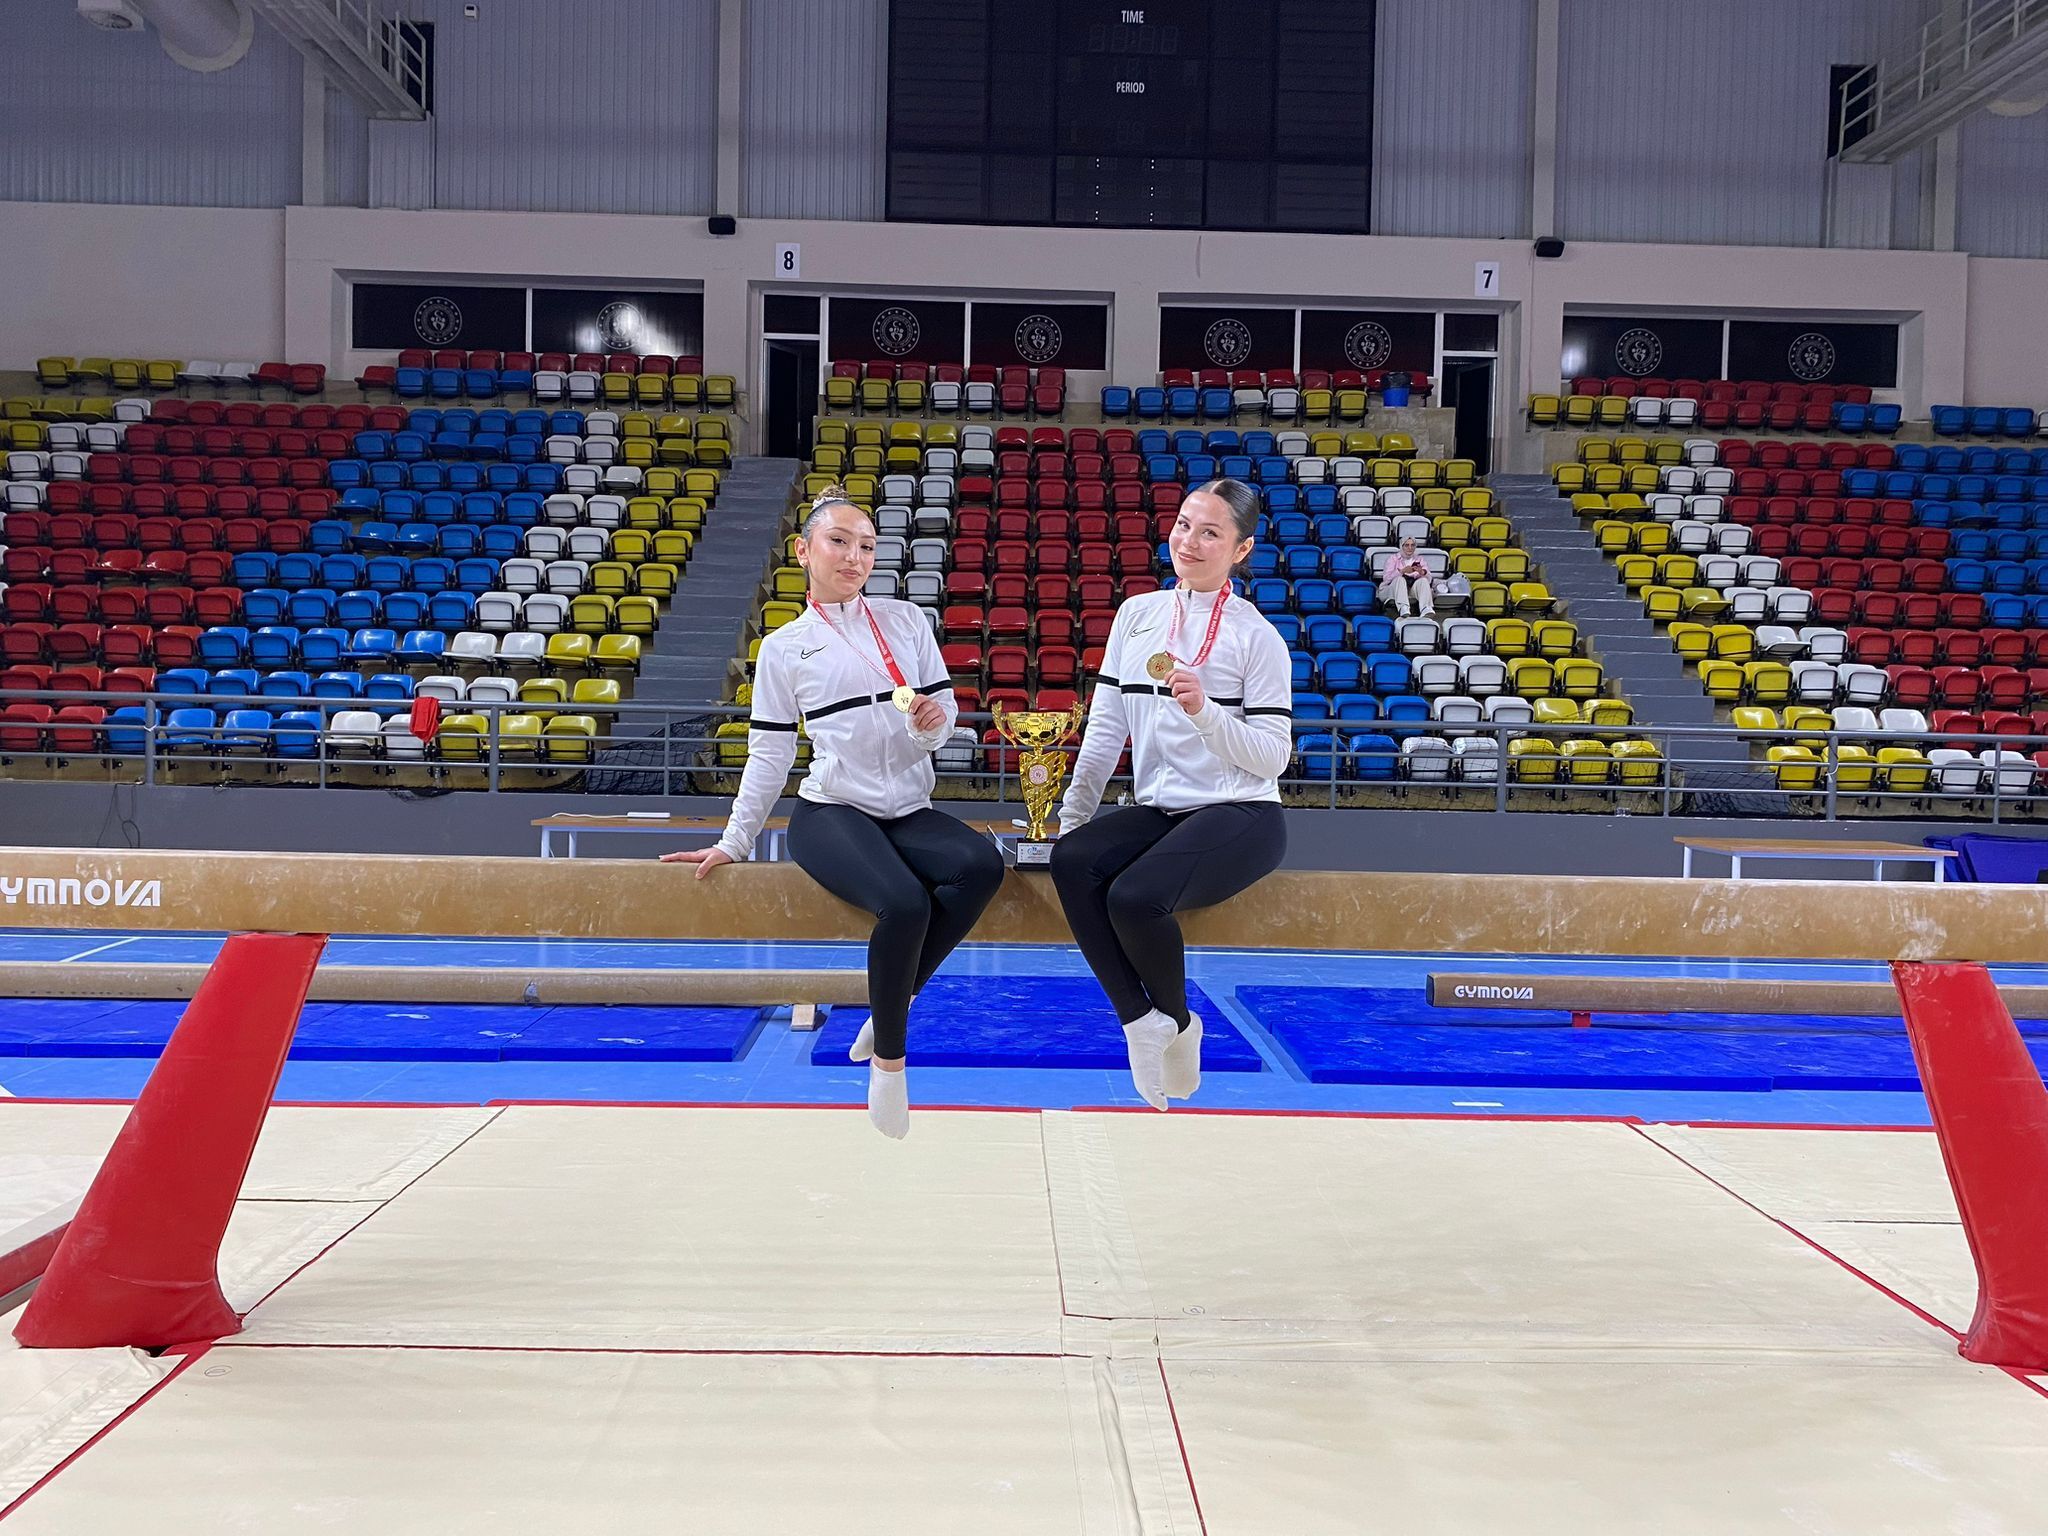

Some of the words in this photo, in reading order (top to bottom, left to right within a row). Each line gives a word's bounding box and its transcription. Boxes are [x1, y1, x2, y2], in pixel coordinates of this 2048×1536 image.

[1121, 10, 1144, 23] TIME
[1116, 82, 1145, 93] PERIOD
[783, 250, 794, 270] 8
[1482, 269, 1493, 288] 7
[1454, 985, 1534, 999] GYMNOVA
